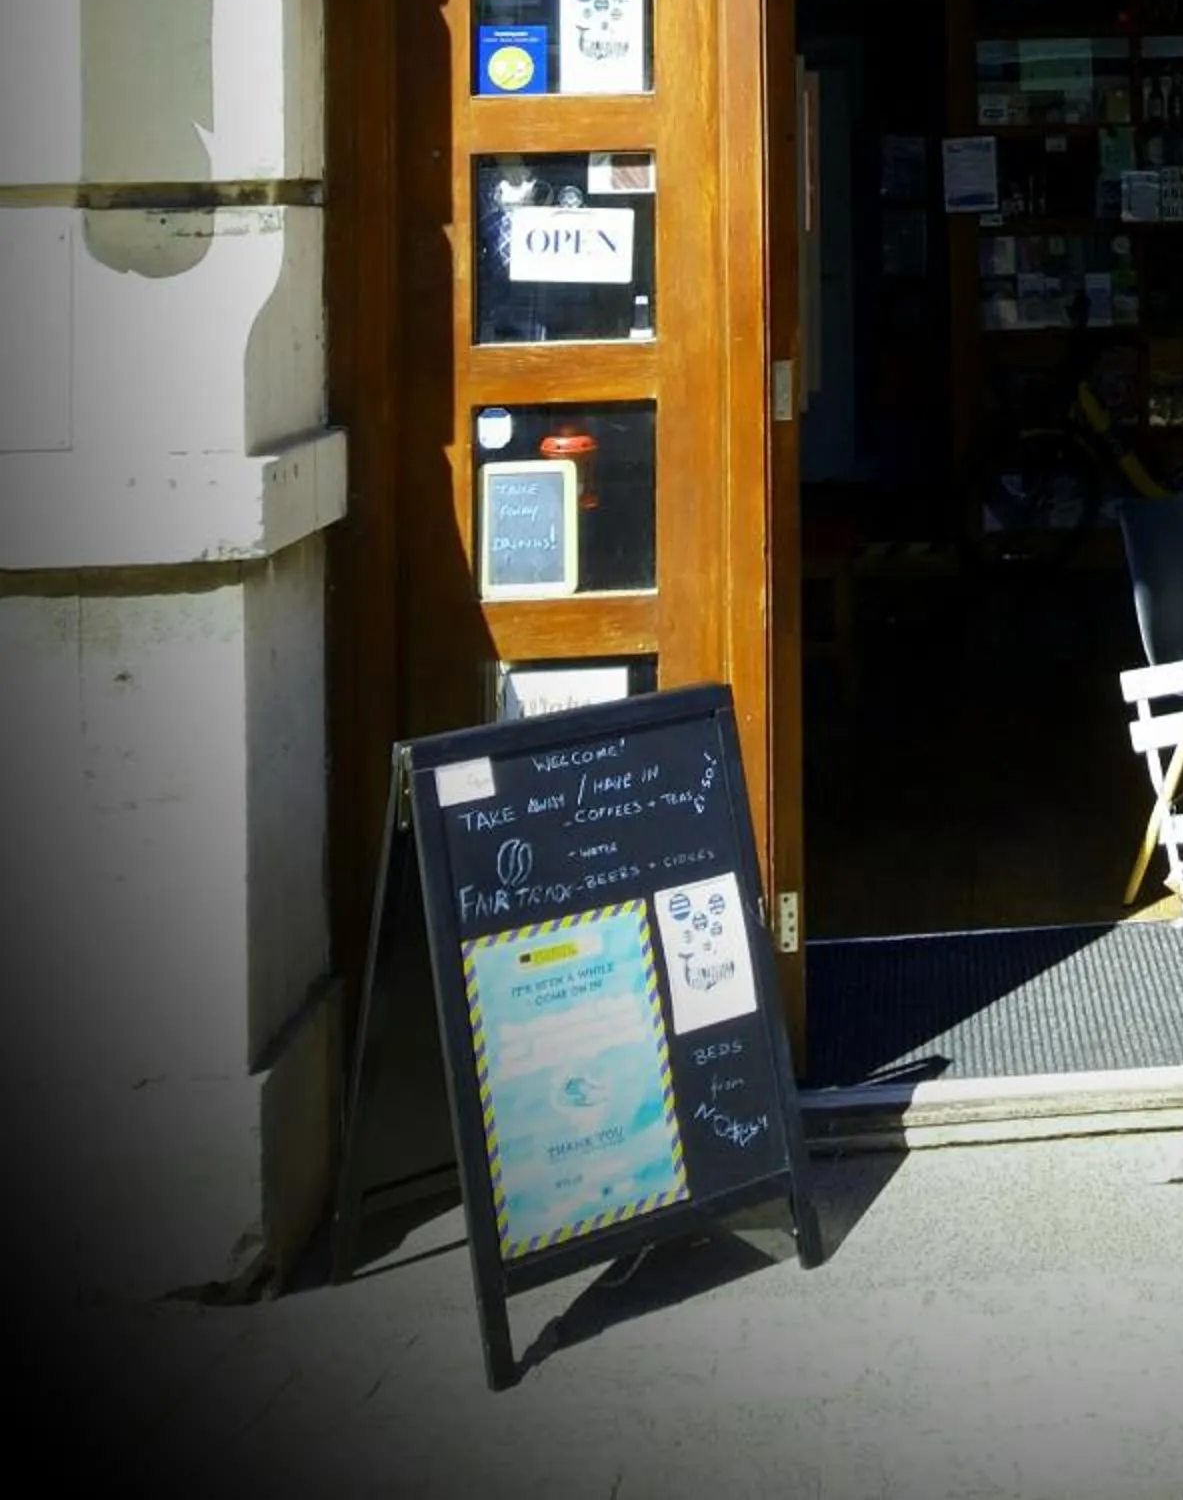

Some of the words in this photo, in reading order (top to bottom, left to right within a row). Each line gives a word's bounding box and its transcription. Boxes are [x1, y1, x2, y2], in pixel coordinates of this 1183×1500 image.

[525, 228, 620, 255] OPEN
[457, 805, 518, 832] TAKE
[593, 771, 633, 795] HAVE
[640, 763, 660, 784] IN
[458, 883, 511, 925] FAIR
[693, 1038, 744, 1066] BEDS
